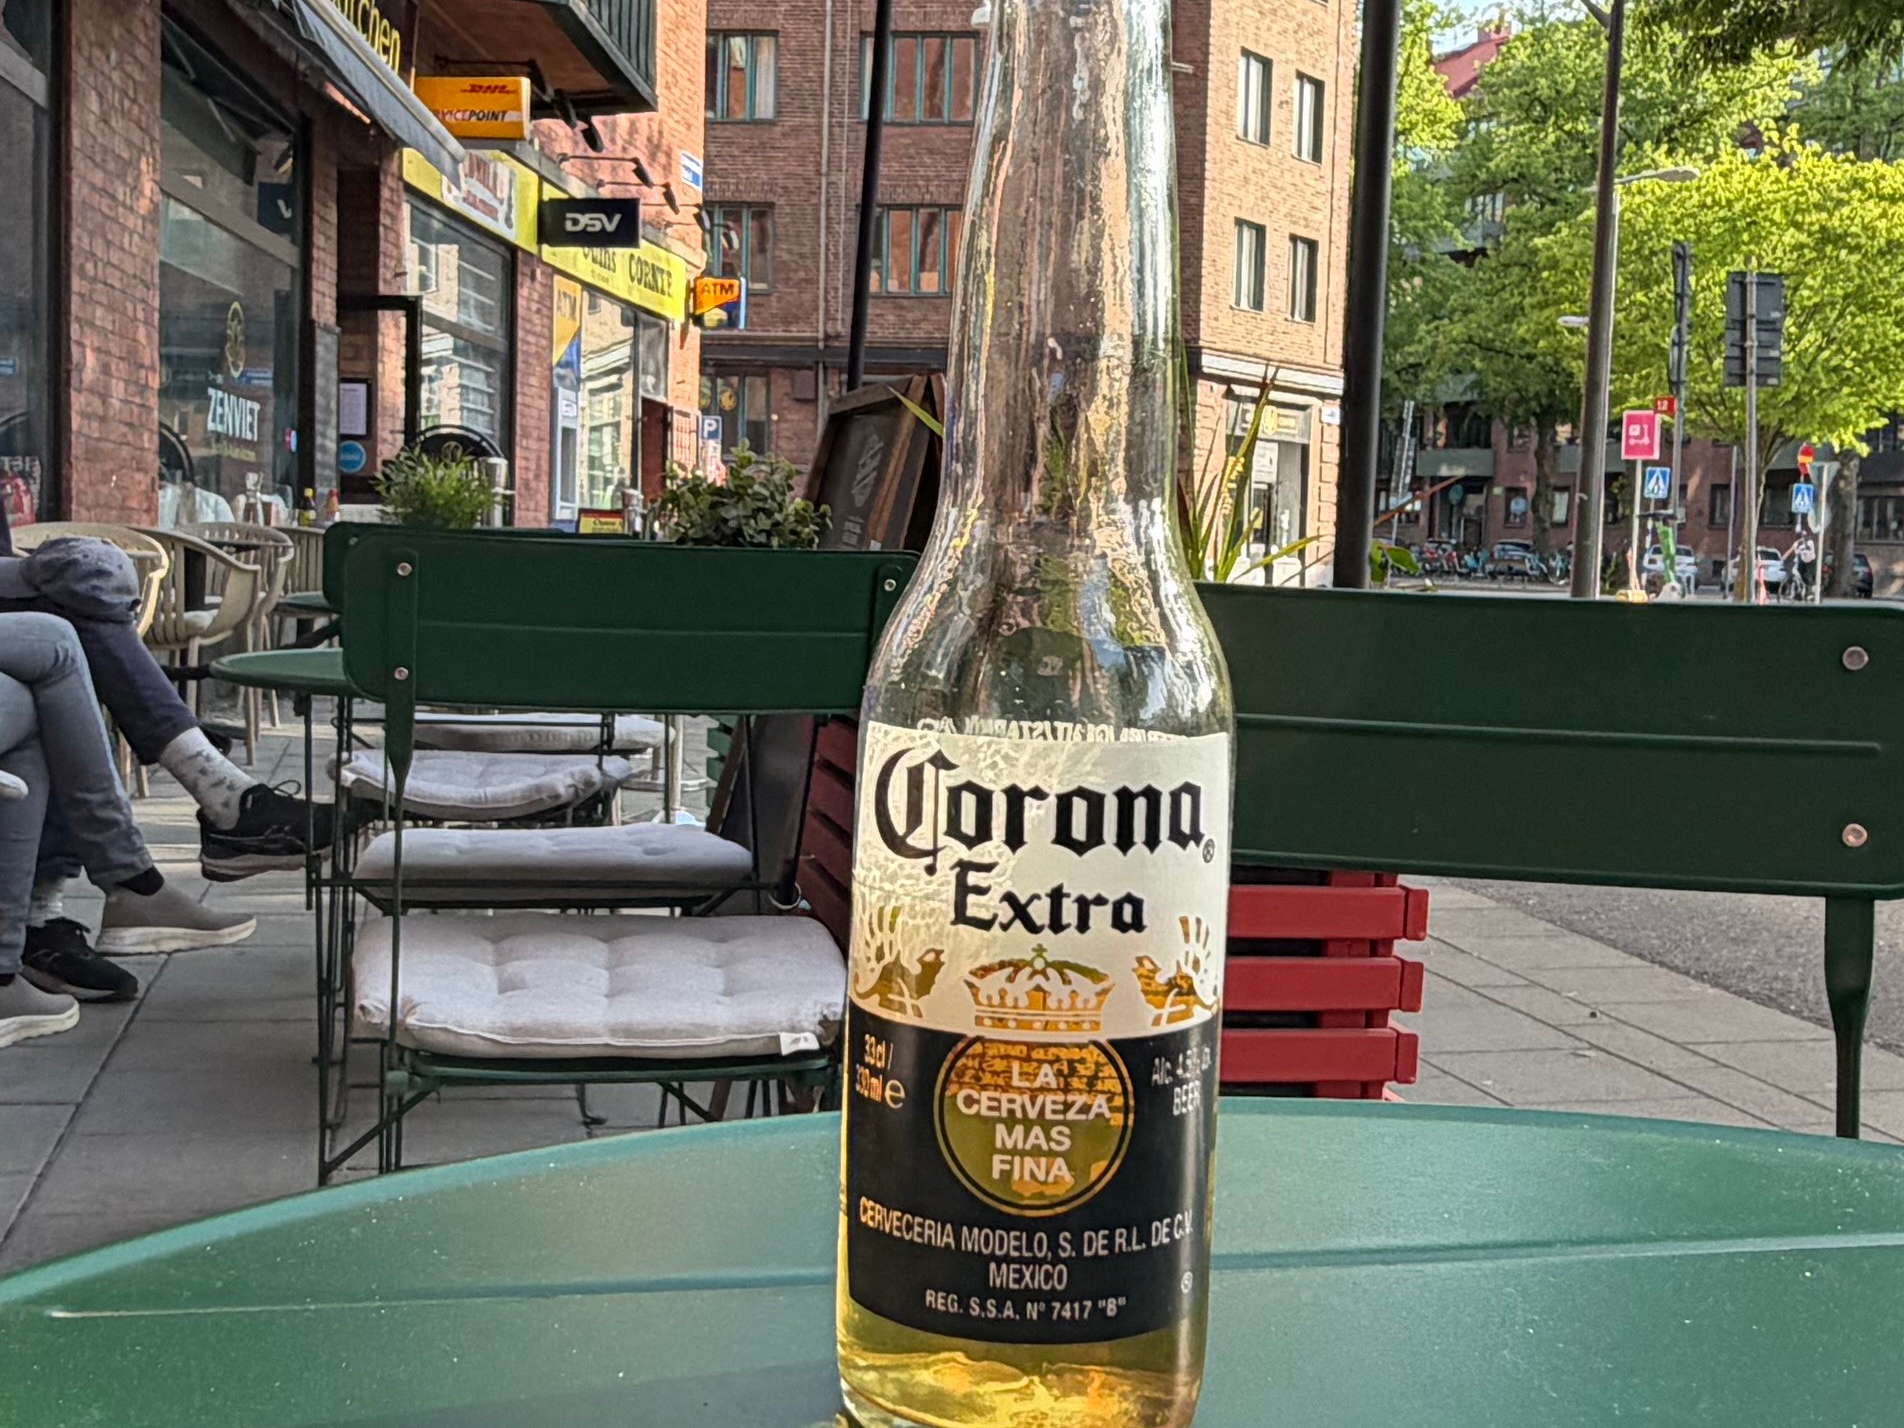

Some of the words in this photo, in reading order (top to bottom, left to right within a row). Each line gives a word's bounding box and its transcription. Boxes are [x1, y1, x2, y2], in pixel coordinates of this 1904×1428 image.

[564, 212, 623, 233] DSV
[700, 283, 736, 296] ATM
[207, 386, 261, 442] ZENVIET
[704, 418, 718, 439] P
[874, 748, 1204, 876] Corona
[950, 858, 1148, 935] Extra
[1012, 1063, 1058, 1089] LA
[956, 1088, 1111, 1121] CERVEZA
[995, 1123, 1072, 1152] MAS
[992, 1154, 1072, 1183] FINA
[859, 1195, 955, 1251] CERVECERIA
[961, 1225, 1053, 1261] MODELO,
[1058, 1231, 1076, 1258] S.
[1083, 1229, 1110, 1257] DE
[1114, 1226, 1146, 1254] R.L.
[1151, 1217, 1172, 1248] DE
[988, 1261, 1069, 1291] MEXICO
[925, 1288, 964, 1314] REG.
[968, 1296, 1021, 1320] S.S.A.
[1051, 1300, 1093, 1321] 7417
